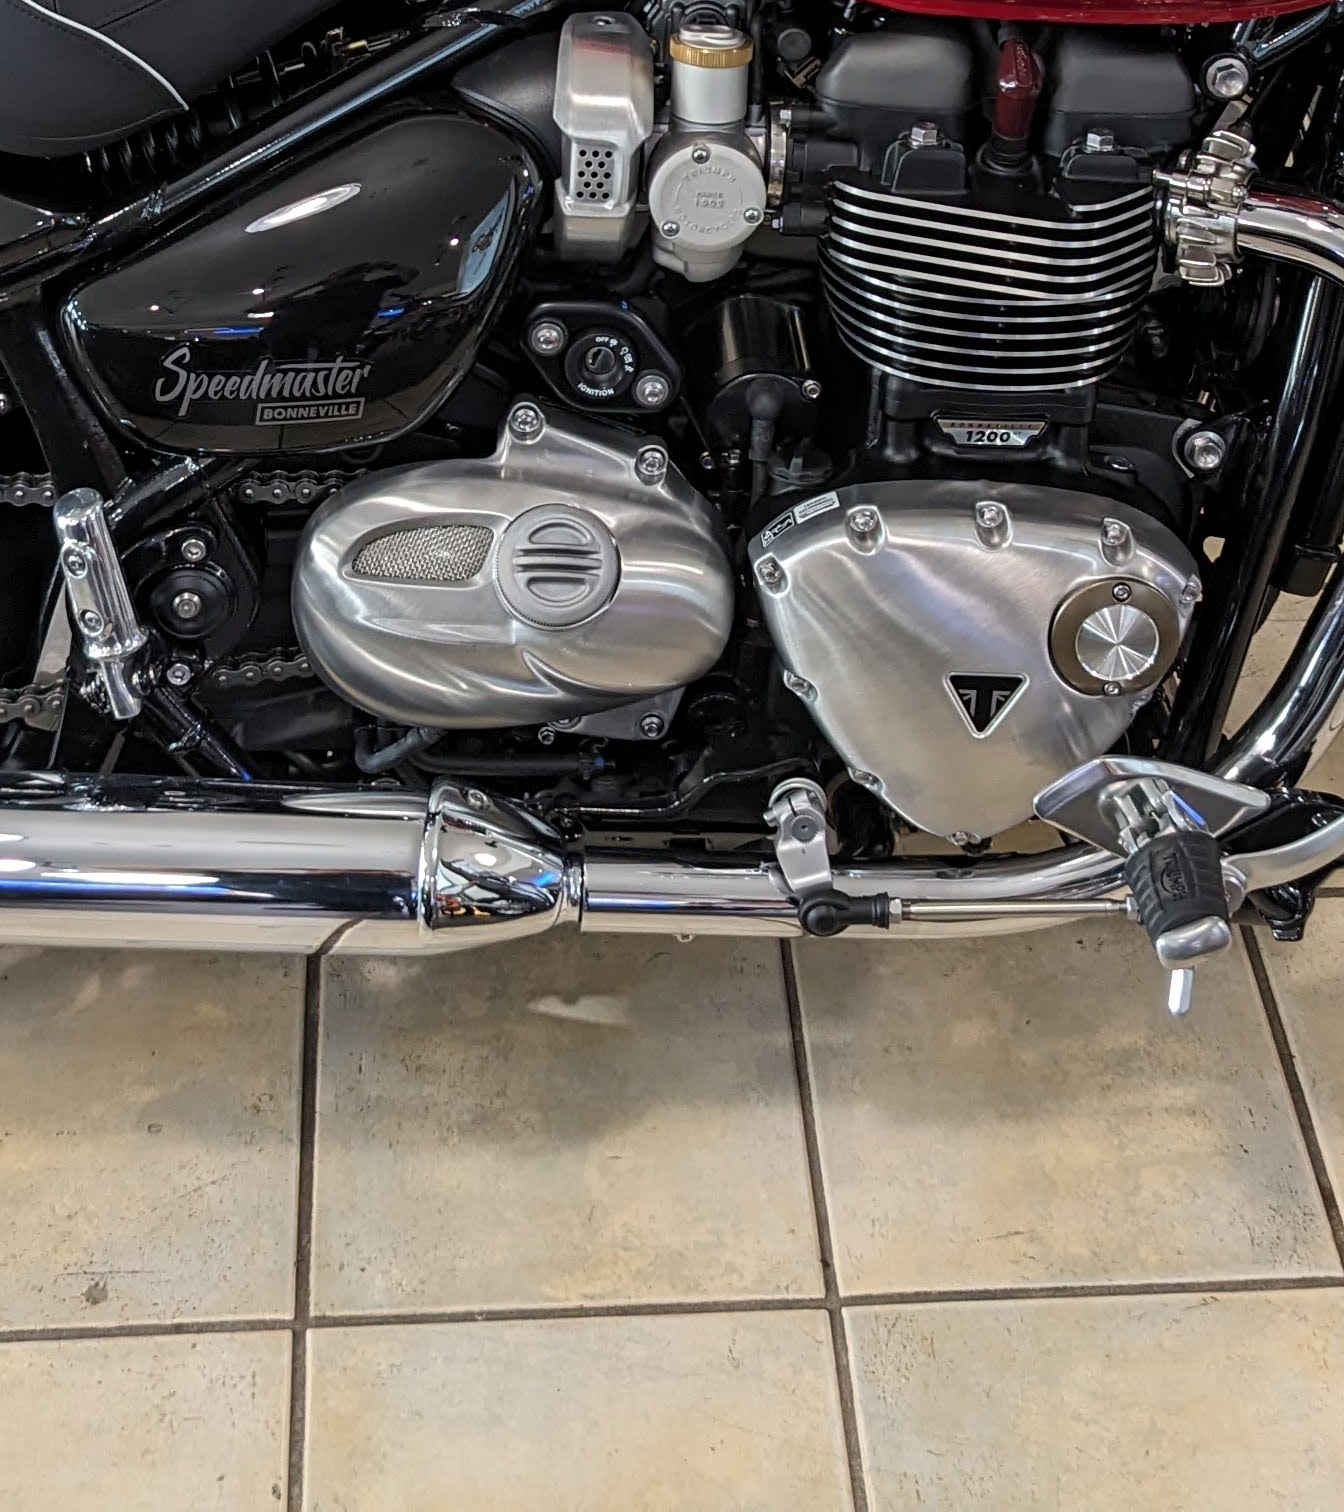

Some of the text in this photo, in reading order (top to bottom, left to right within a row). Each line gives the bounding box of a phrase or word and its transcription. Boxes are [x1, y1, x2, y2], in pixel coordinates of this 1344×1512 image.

[155, 346, 370, 417] Speedmaster
[577, 382, 615, 397] IGNITION
[262, 403, 357, 420] BONNEVILLE
[965, 430, 1011, 443] 1200
